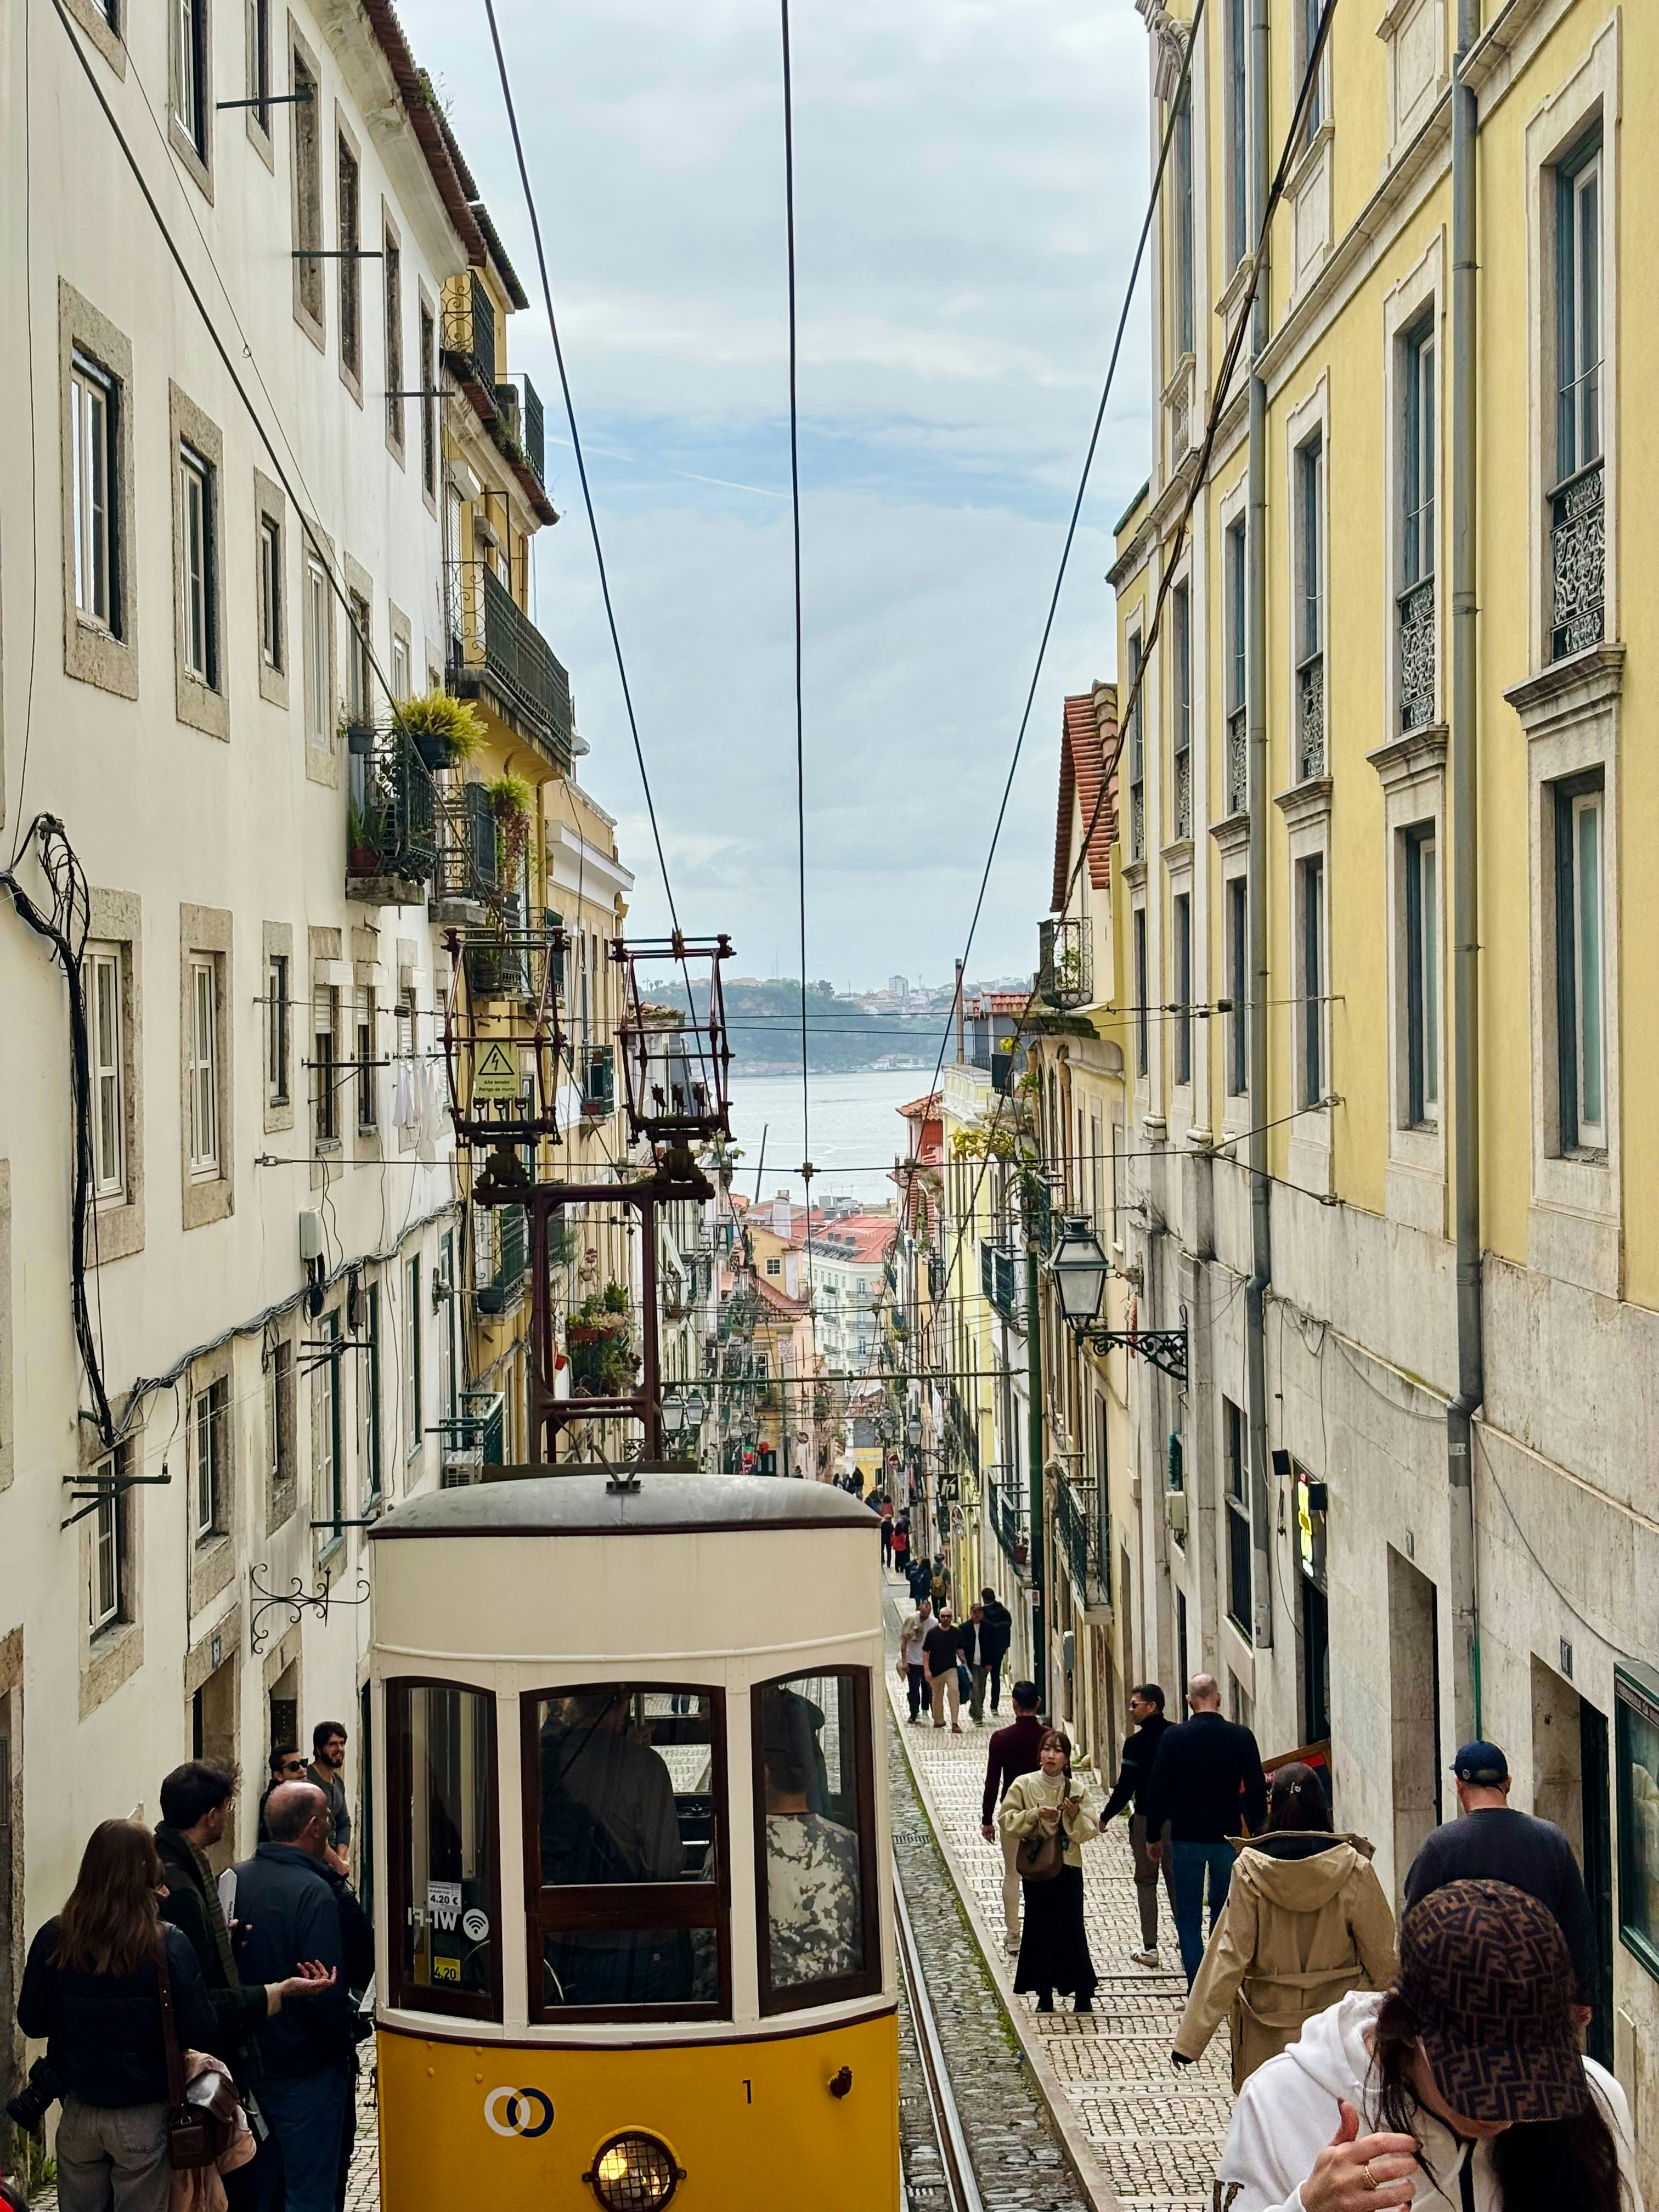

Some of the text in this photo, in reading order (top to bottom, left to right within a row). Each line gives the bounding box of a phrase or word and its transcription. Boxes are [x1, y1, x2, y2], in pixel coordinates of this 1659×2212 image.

[430, 1894, 459, 1905] 4.20 €
[742, 2079, 752, 2104] 1
